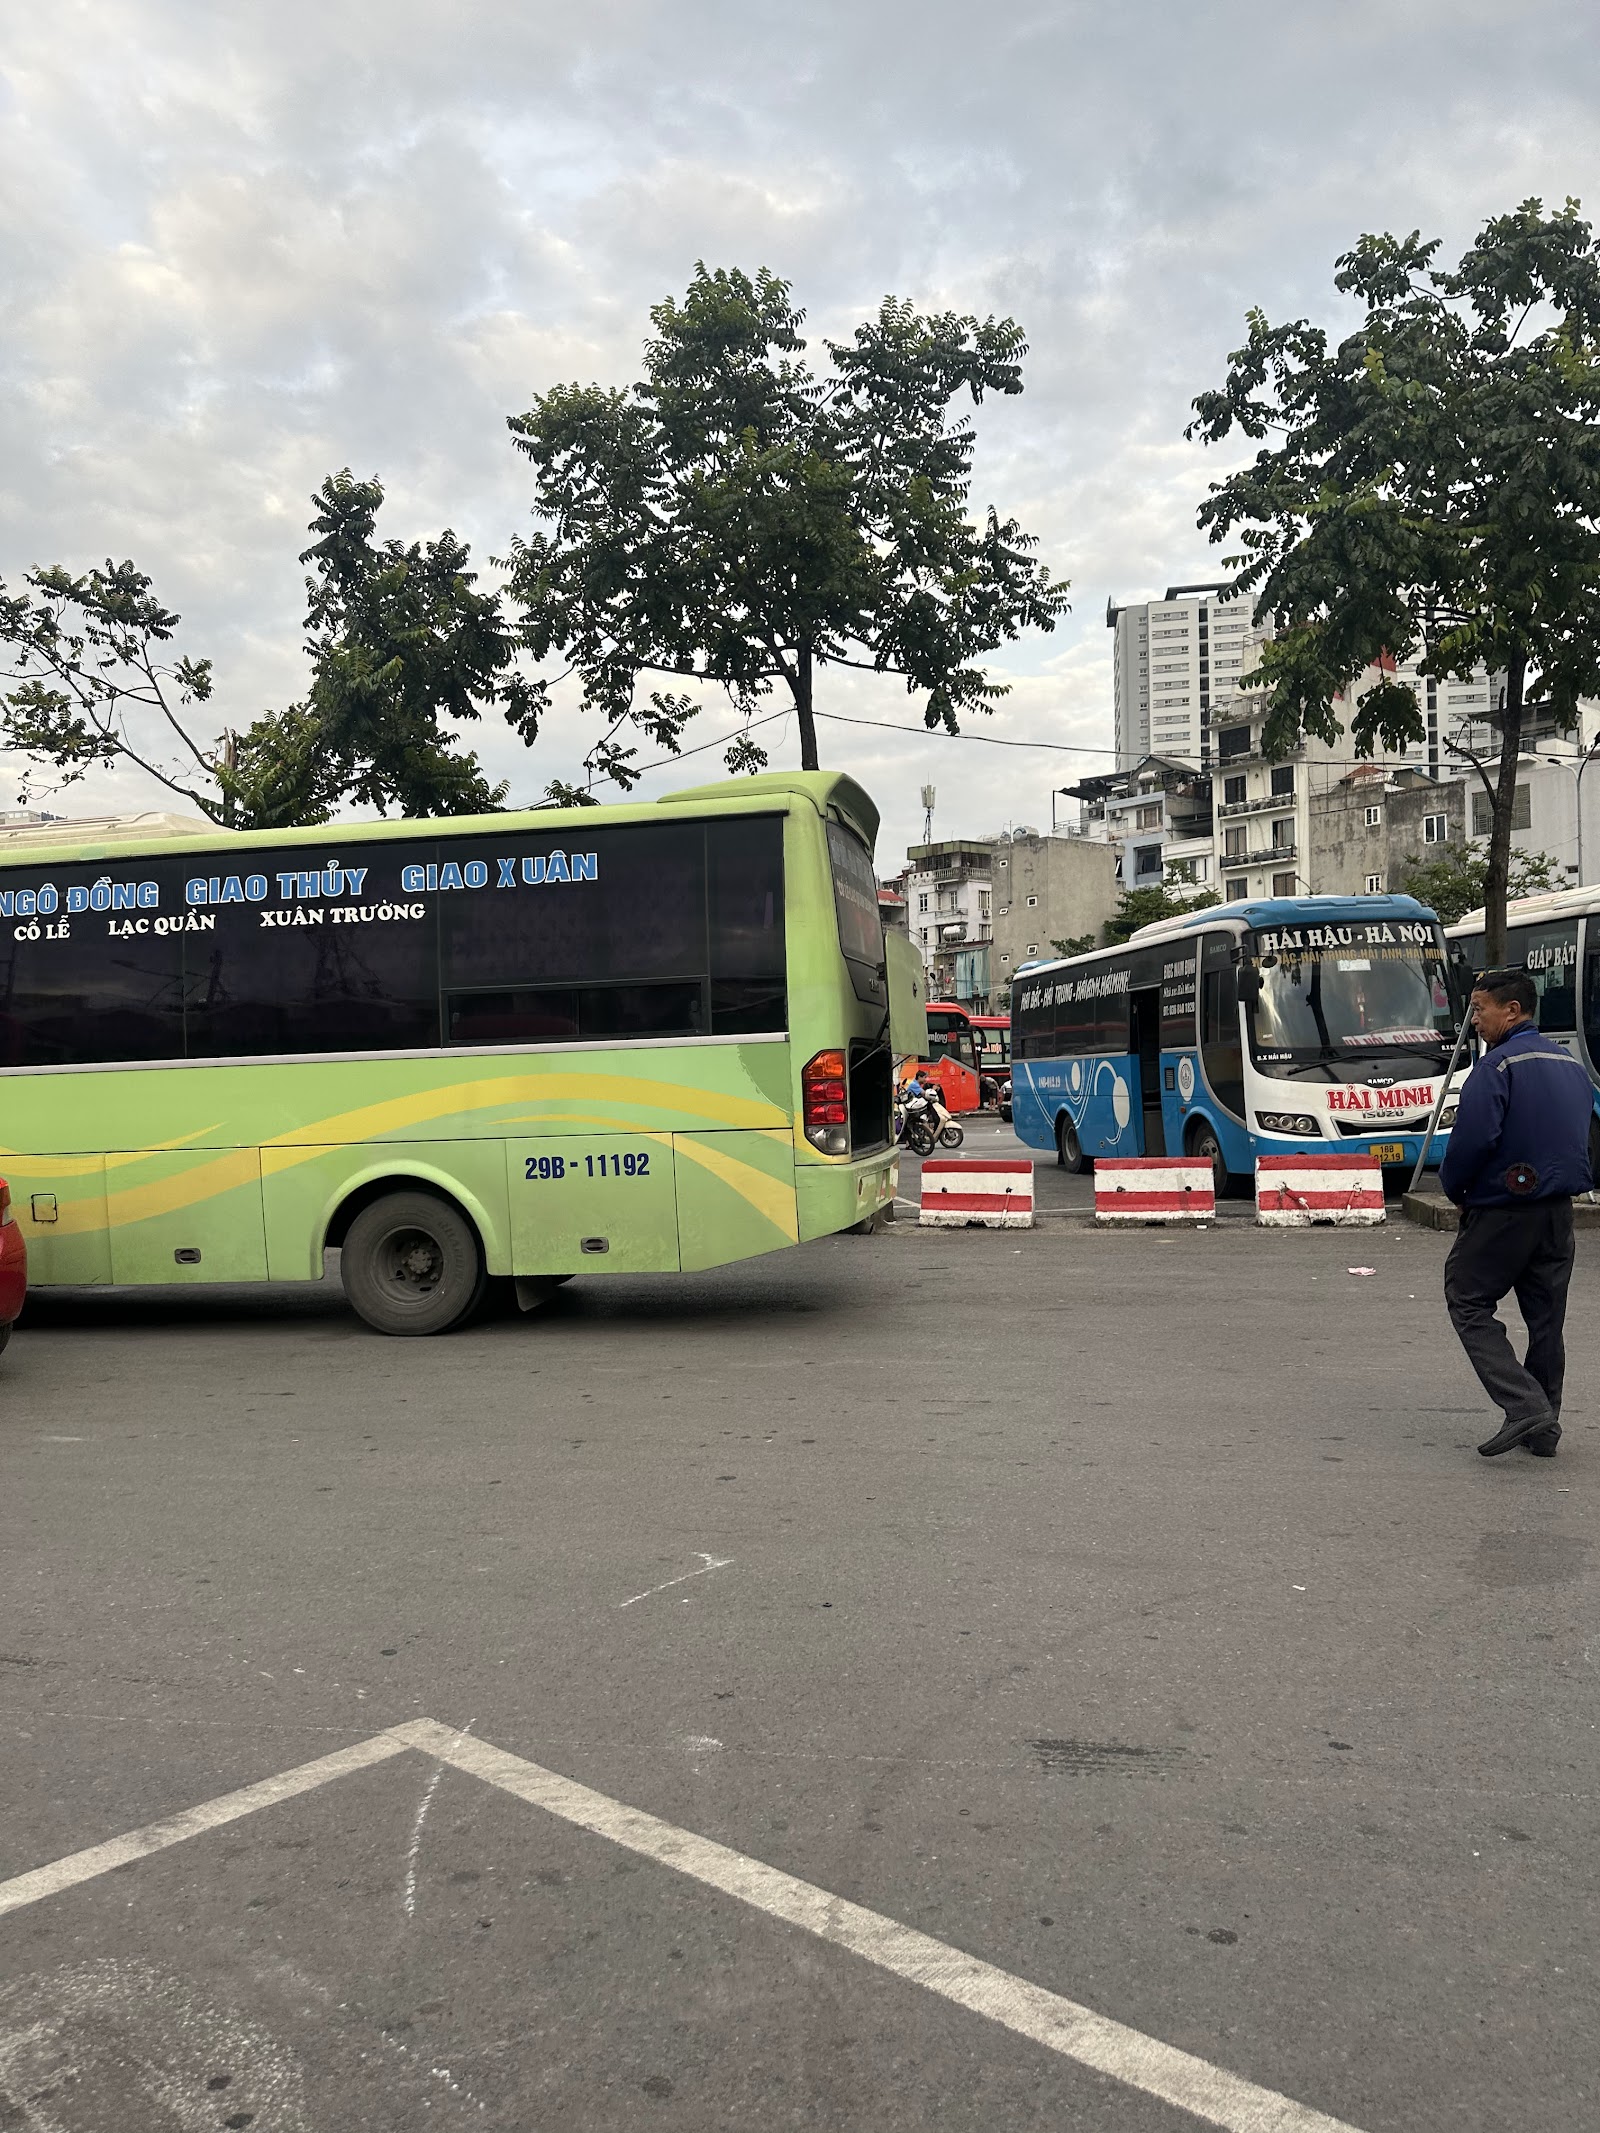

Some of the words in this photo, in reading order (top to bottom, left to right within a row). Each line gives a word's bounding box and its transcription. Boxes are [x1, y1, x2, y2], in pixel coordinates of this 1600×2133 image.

[0, 882, 59, 917] NGÔ
[66, 876, 160, 913] ĐỒNG
[185, 874, 268, 905] GIAO
[276, 860, 368, 900] THỦY
[401, 860, 488, 893] GIAO
[14, 917, 41, 941] CỔ
[46, 915, 71, 940] LỄ
[108, 918, 150, 940] LẠC
[154, 907, 216, 936] QUẦN
[259, 906, 324, 928] XUÂN
[329, 899, 427, 924] TRƯỜNG
[1261, 925, 1304, 951] HẢI
[1307, 924, 1353, 949] HẬU
[1365, 922, 1397, 944] HÀ
[1398, 921, 1435, 947] NỘI
[1527, 944, 1553, 970] GIÁP
[1553, 941, 1577, 966] BÁT
[1367, 1077, 1394, 1085] SAMCO
[1327, 1083, 1373, 1111] HẢI
[1375, 1085, 1435, 1110] MINH
[1362, 1109, 1405, 1119] ISUZU
[1380, 1145, 1394, 1154] 18B
[524, 1155, 566, 1181] 29B
[584, 1152, 651, 1178] 11192
